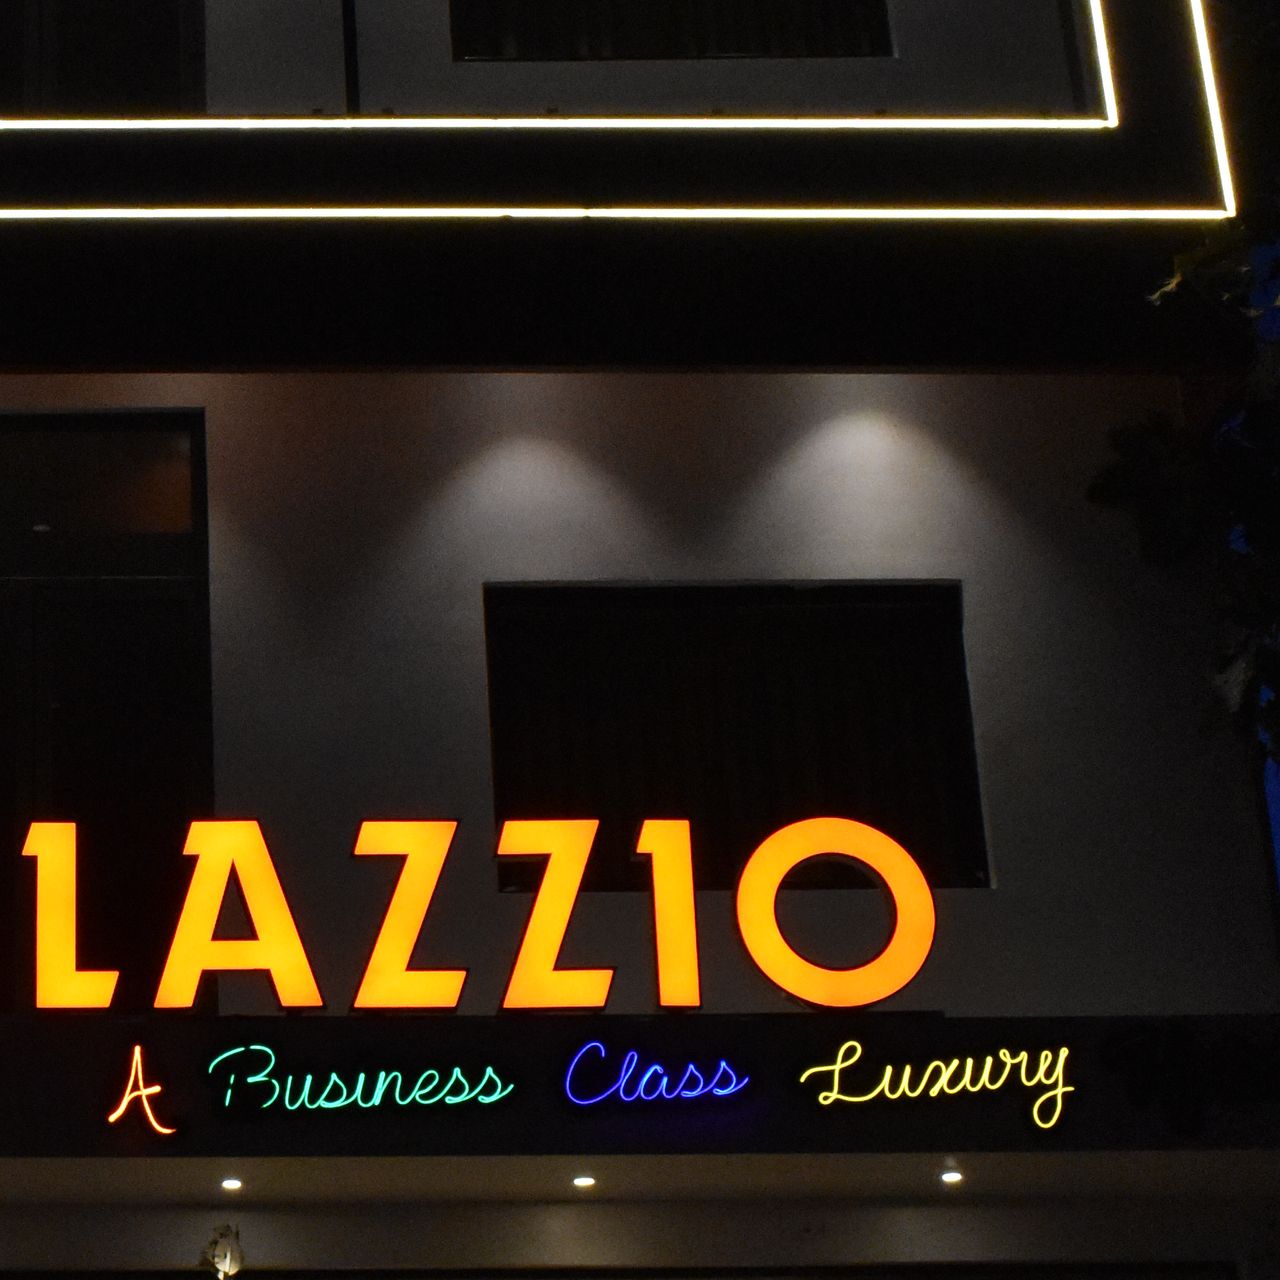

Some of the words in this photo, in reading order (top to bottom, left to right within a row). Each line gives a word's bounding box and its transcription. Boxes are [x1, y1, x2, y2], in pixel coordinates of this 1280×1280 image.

[108, 1045, 177, 1135] A
[209, 1045, 514, 1111] Business
[565, 1041, 749, 1106] Class
[800, 1041, 1074, 1129] Luxury
